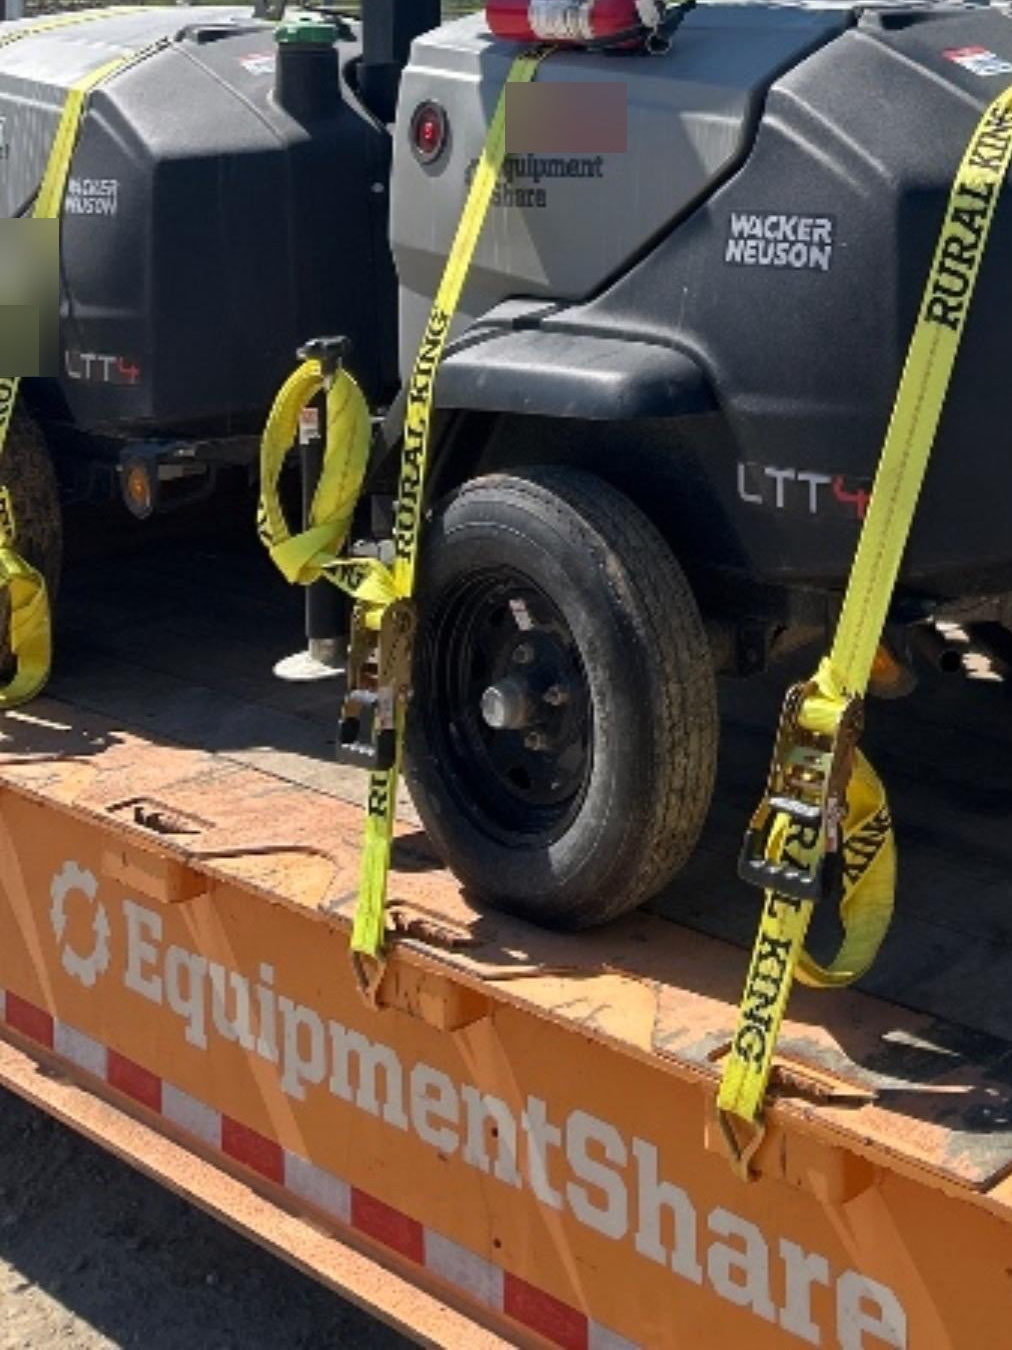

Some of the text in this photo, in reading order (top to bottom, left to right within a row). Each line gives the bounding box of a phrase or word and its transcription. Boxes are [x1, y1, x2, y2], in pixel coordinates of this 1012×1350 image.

[725, 238, 833, 271] NEUSON
[730, 212, 833, 244] WACKER
[924, 181, 997, 333] RURAL
[64, 350, 140, 384] LTT4
[396, 309, 448, 562] RURAL KING
[737, 461, 873, 518] LTT4
[734, 935, 793, 1074] KING
[123, 897, 908, 1350] EquipmentShare
